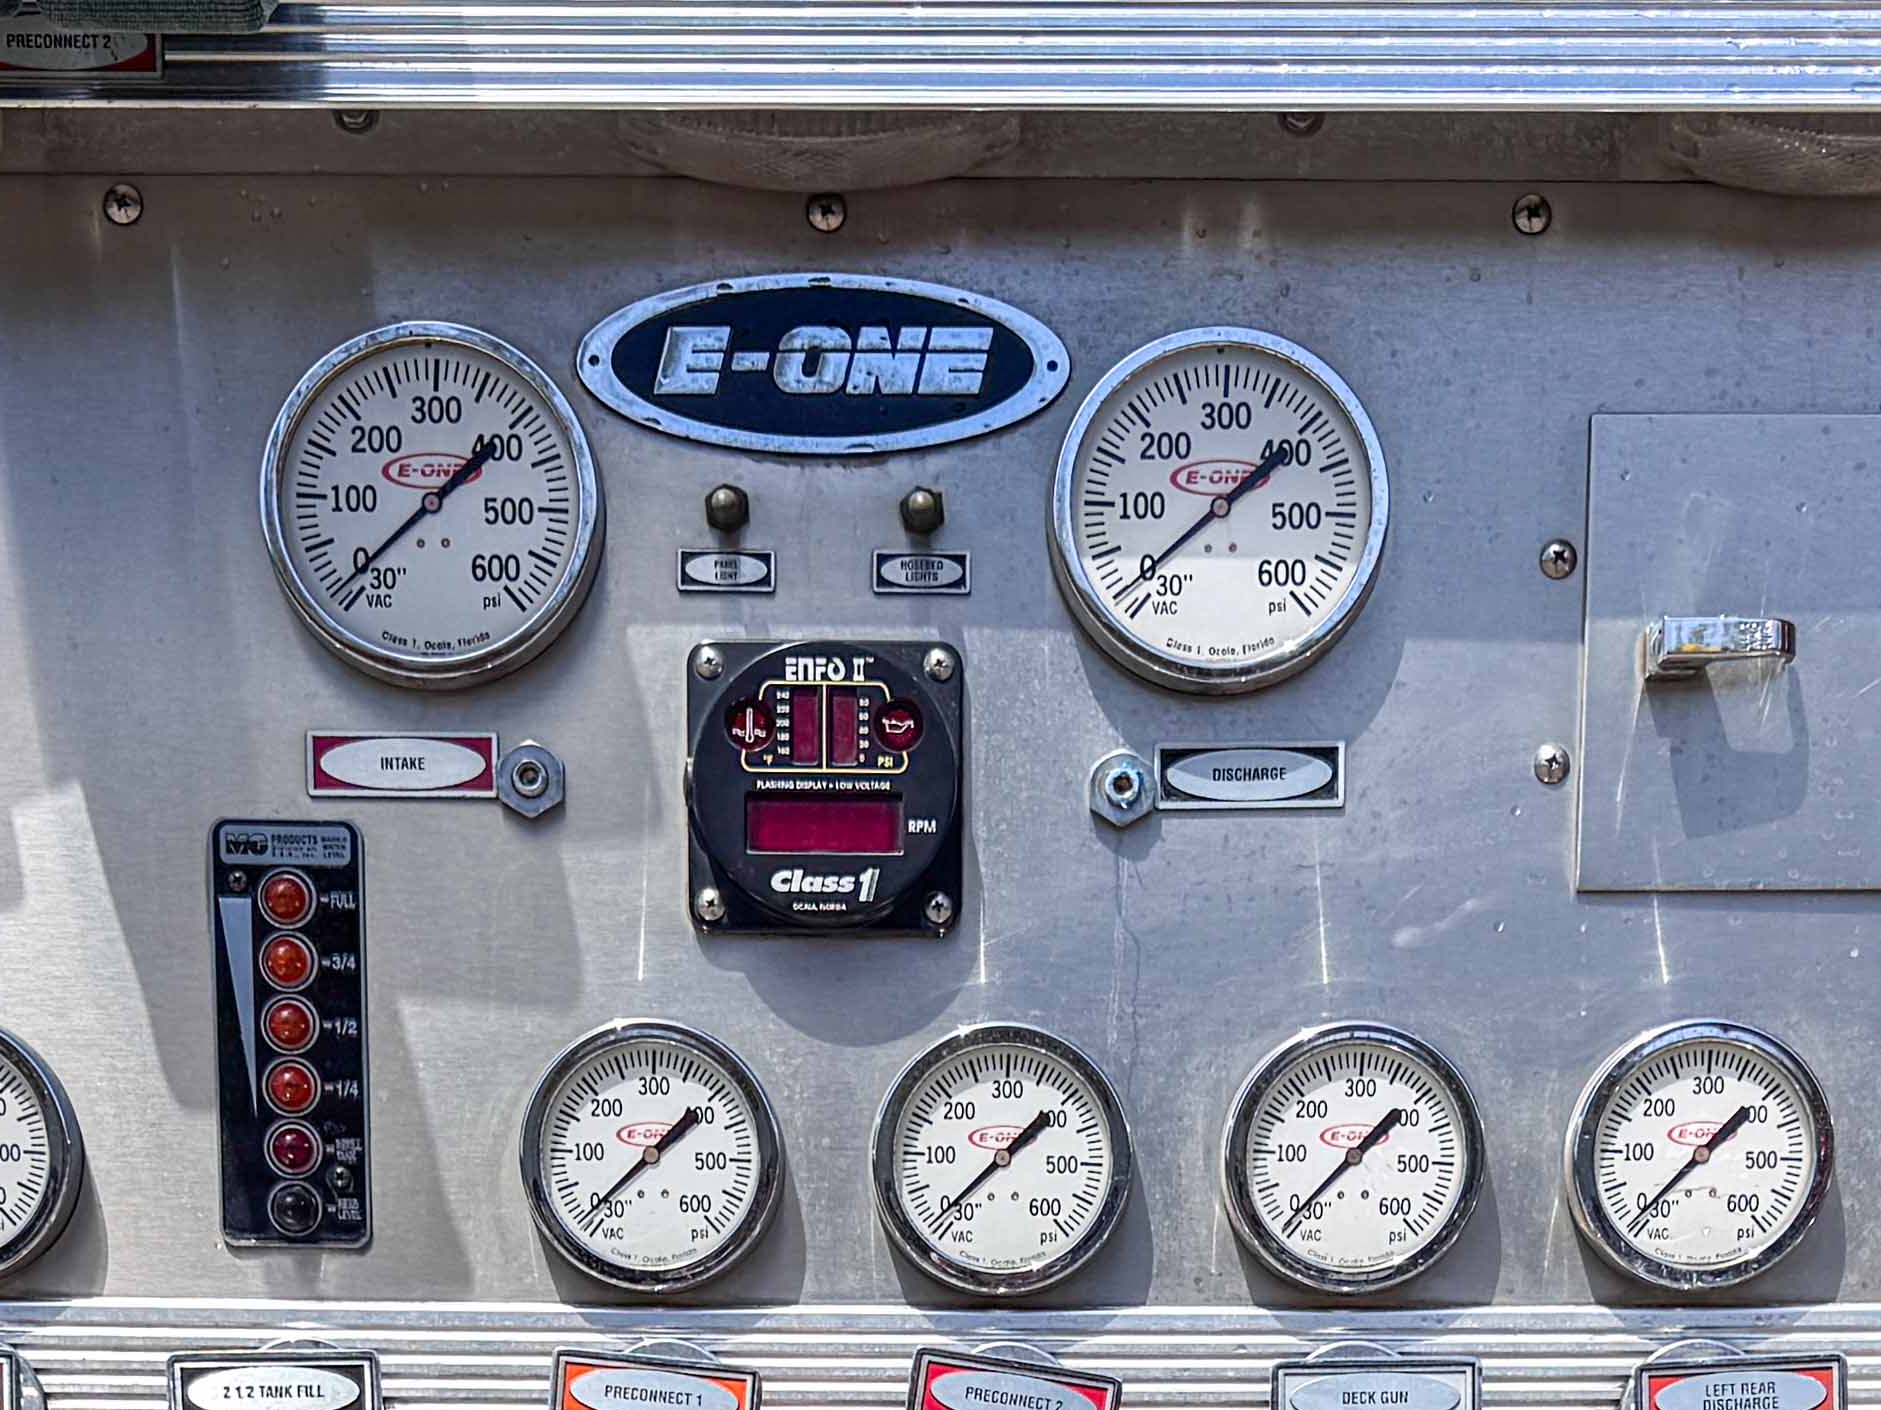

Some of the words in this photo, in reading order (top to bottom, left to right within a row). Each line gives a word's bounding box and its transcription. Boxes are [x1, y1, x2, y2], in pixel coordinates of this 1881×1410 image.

[5, 33, 98, 49] PRECONNECT
[103, 33, 112, 49] 2
[653, 325, 994, 395] E-ONE
[410, 395, 463, 425] 300
[1200, 401, 1252, 431] 300
[350, 425, 402, 454] 200
[1139, 431, 1192, 461] 200
[330, 484, 377, 513] 100
[1119, 491, 1166, 520] 100
[483, 497, 534, 526] 500
[1271, 501, 1322, 531] 500
[471, 554, 521, 583] 600
[1258, 558, 1307, 587] 600
[366, 593, 393, 610] VAC
[482, 593, 502, 610] psi
[785, 657, 846, 681] ENFO
[380, 756, 425, 771] INTAKE
[877, 755, 894, 769] PSI
[1212, 767, 1287, 782] DISCHARGE
[908, 819, 937, 834] RPM
[331, 953, 356, 971] 3/4
[334, 1018, 358, 1036] 1/2
[336, 1080, 359, 1097] 1/4
[638, 1076, 671, 1096] 300
[991, 1080, 1024, 1099] 300
[1344, 1078, 1377, 1098] 300
[1692, 1076, 1725, 1095] 300
[694, 1151, 727, 1171] 500
[1397, 1154, 1430, 1173] 500
[223, 1386, 231, 1399] 2
[246, 1386, 255, 1399] 2
[258, 1384, 292, 1399] TANK
[297, 1384, 326, 1398] FILL
[604, 1384, 692, 1406] PRECONNECT
[696, 1394, 702, 1407] 1
[964, 1386, 1051, 1410] PRECONNECT
[1341, 1390, 1377, 1405] DECK
[1380, 1390, 1409, 1405] GUN
[1705, 1382, 1736, 1397] LEFT
[1740, 1381, 1776, 1396] REAR
